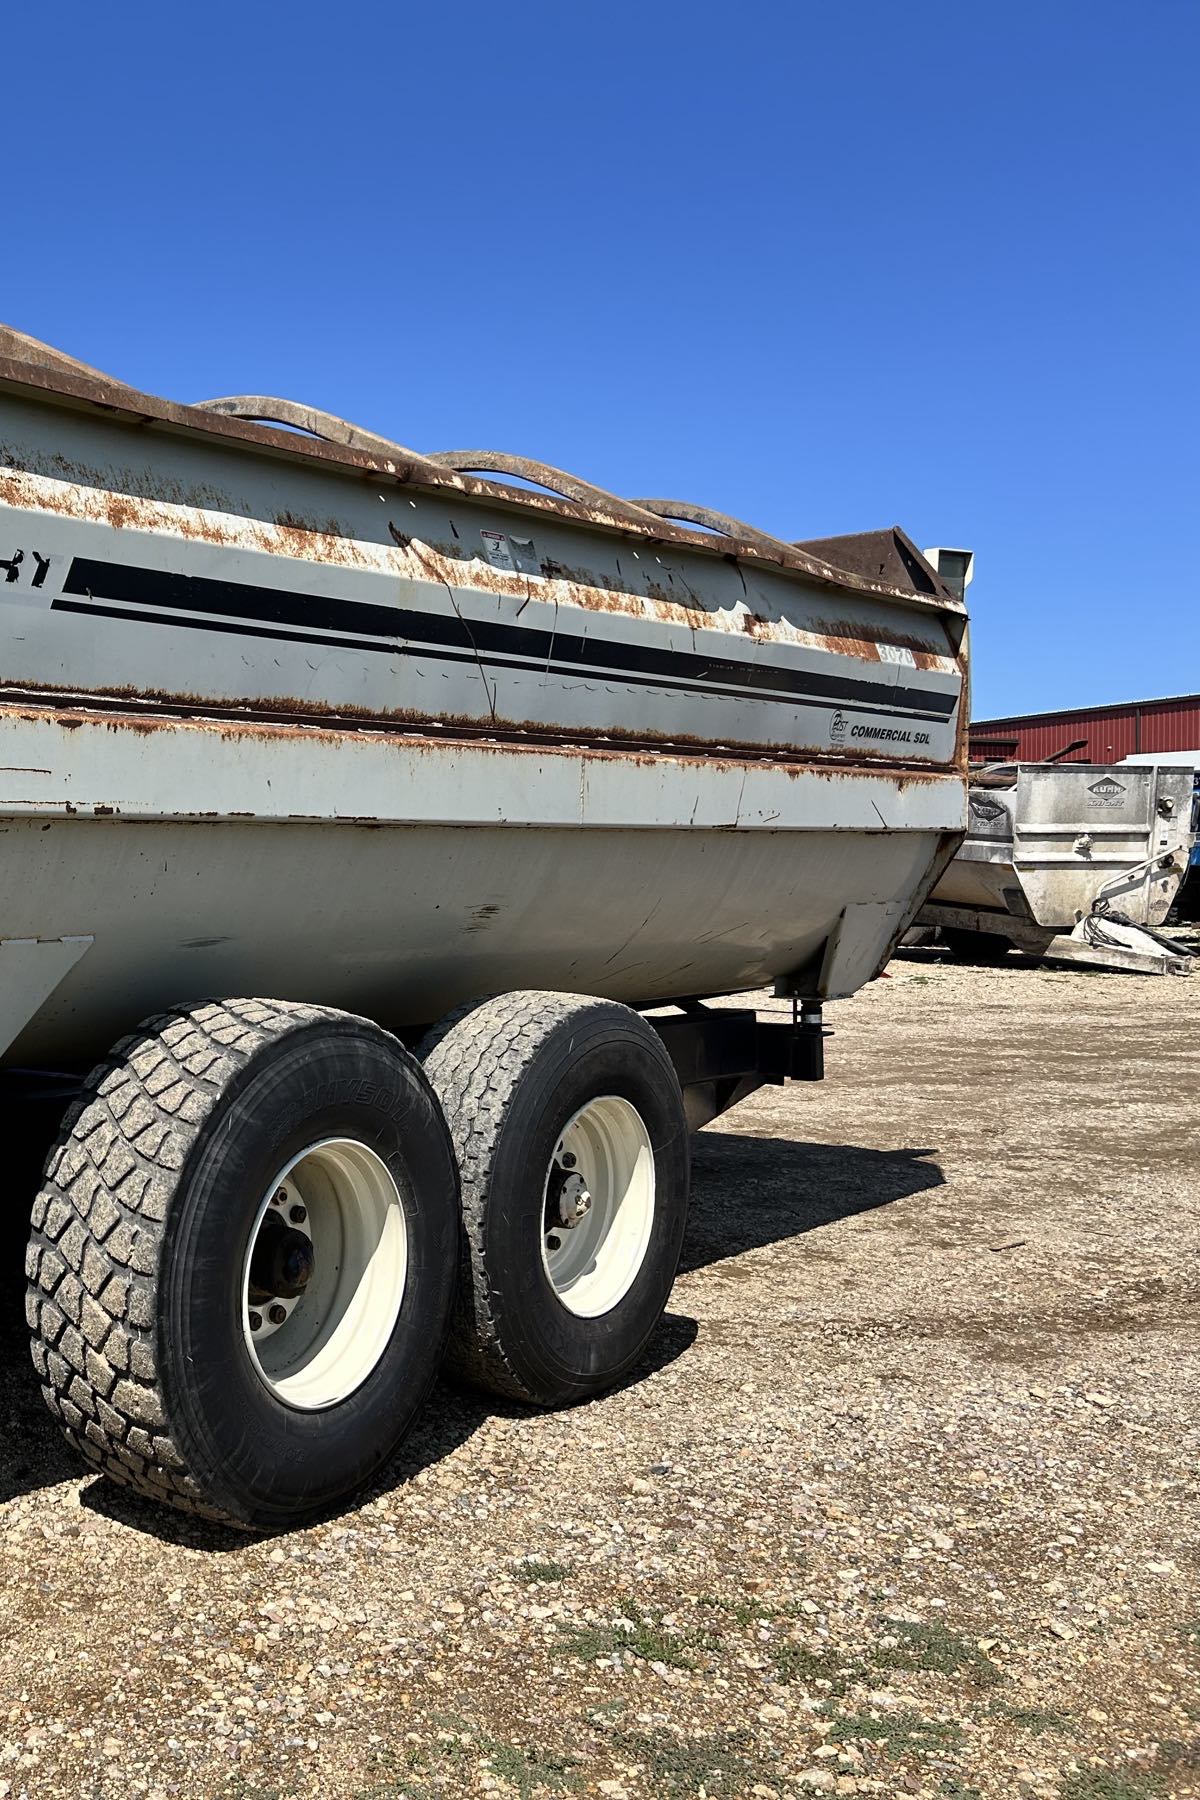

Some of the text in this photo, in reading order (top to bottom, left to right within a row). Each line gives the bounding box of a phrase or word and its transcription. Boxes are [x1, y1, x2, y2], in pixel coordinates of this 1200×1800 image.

[850, 725, 930, 745] COMMERCIAL SDL
[1092, 785, 1122, 793] KUHN
